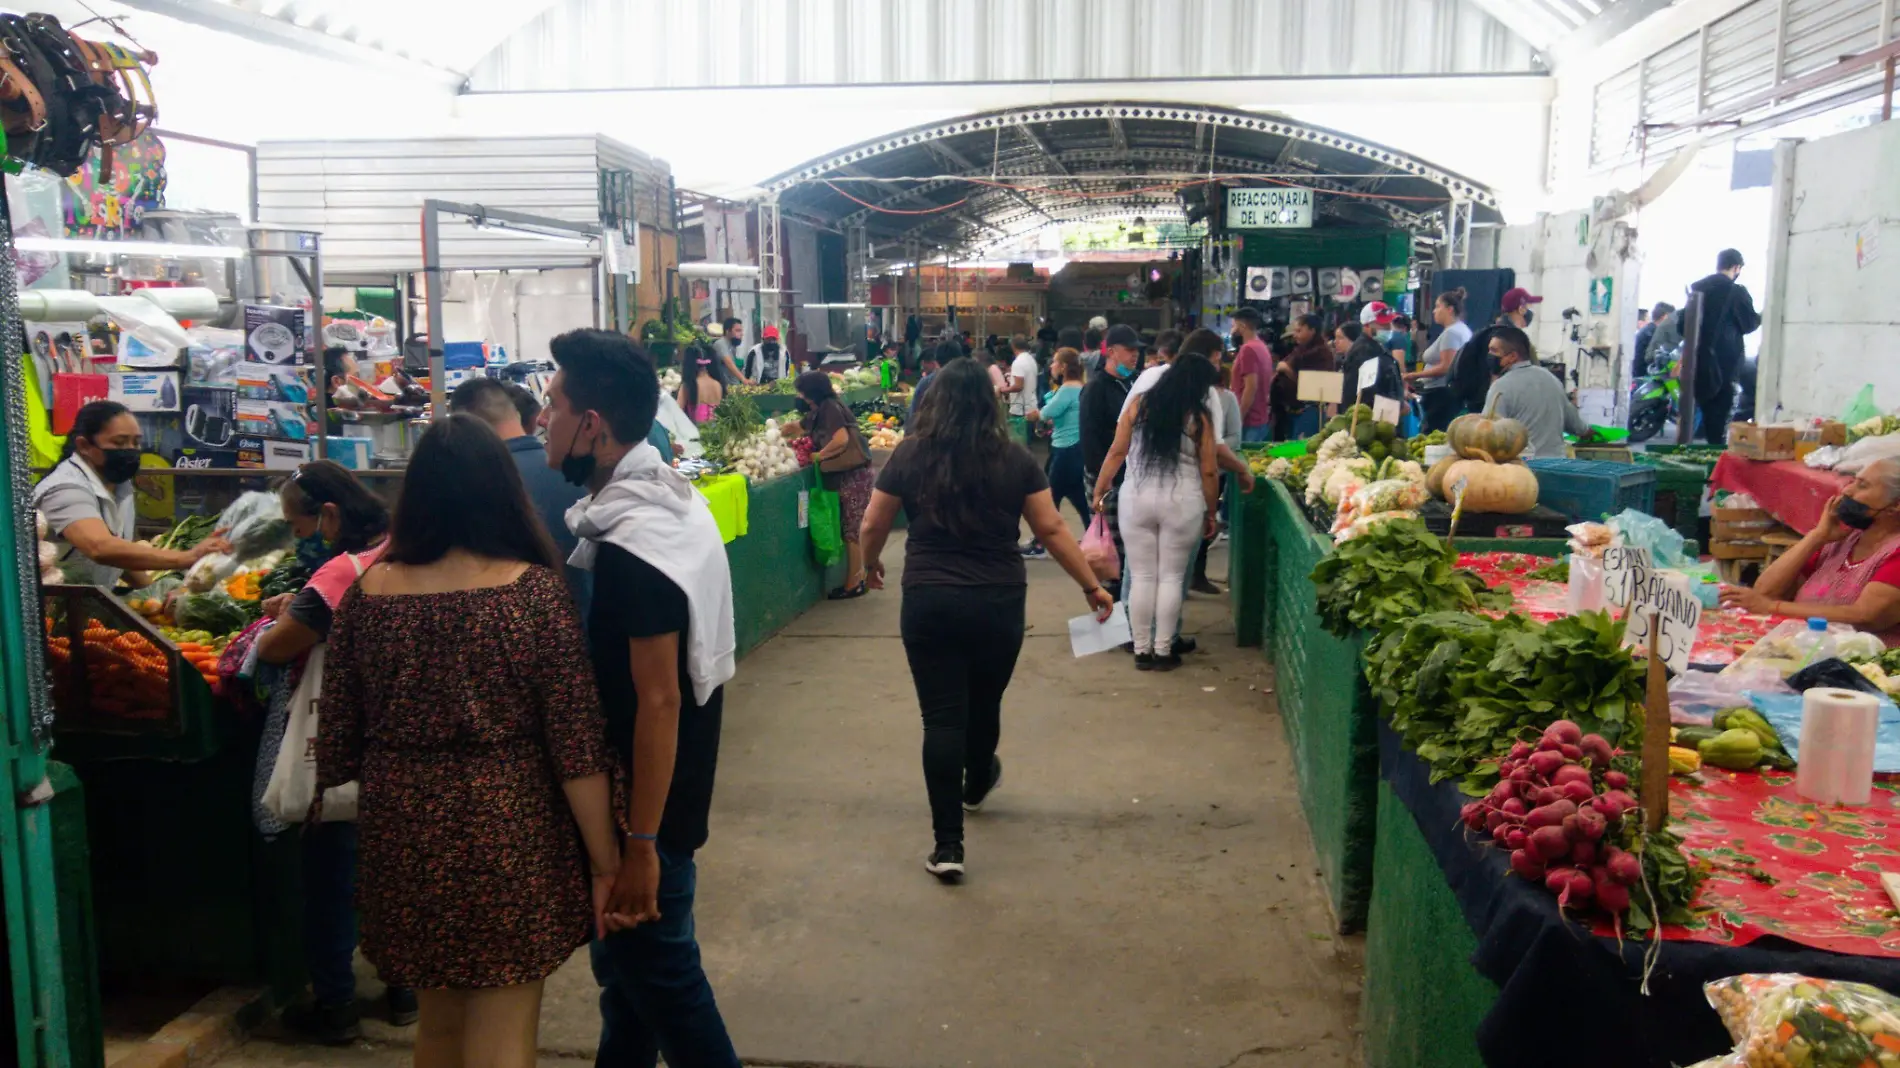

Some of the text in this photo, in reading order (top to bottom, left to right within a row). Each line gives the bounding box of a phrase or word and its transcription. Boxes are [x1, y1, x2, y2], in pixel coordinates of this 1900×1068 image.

[1231, 191, 1309, 207] REFACCIONARIA
[1241, 210, 1299, 225] DEL HOAR
[239, 439, 261, 448] Oster
[176, 456, 212, 469] Oster
